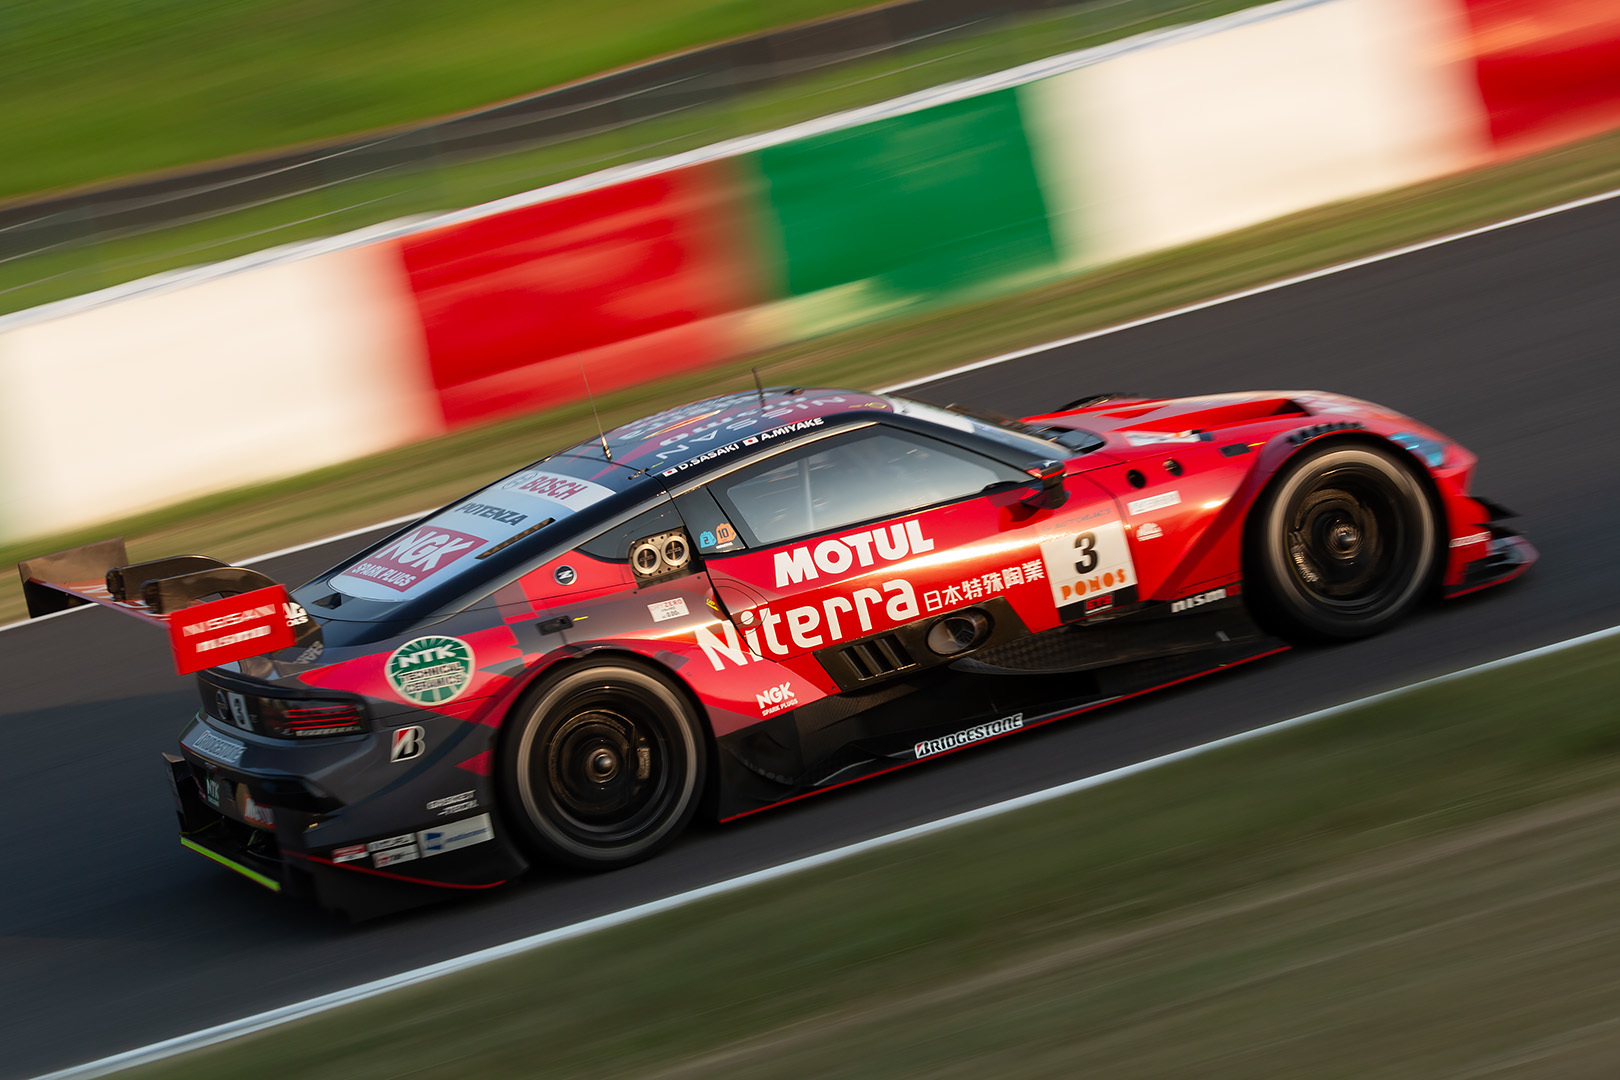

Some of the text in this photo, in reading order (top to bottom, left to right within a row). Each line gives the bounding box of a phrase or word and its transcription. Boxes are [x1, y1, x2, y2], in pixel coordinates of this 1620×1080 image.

[656, 396, 847, 460] NISSAN
[760, 417, 825, 441] A.MIYAKE
[678, 443, 739, 471] D.SASAKI
[519, 476, 588, 500] BOSCH
[455, 502, 528, 526] POTENZA
[703, 536, 710, 545] 2
[717, 527, 729, 540] 10
[375, 530, 475, 572] NGK
[773, 519, 935, 588] MOTUL
[1074, 531, 1099, 575] 3
[352, 562, 416, 587] SPARK PLUGS
[923, 558, 1045, 612] 日本特殊陶業
[1060, 568, 1126, 601] PONOS
[182, 603, 277, 638] NISSAN
[694, 578, 920, 672] Niterra
[398, 643, 457, 669] NTK
[398, 662, 465, 683] TECHNICAL
[755, 681, 795, 709] NGK
[761, 698, 798, 717] SPARK PLUGS
[914, 712, 1024, 759] BRIDGESTONE
